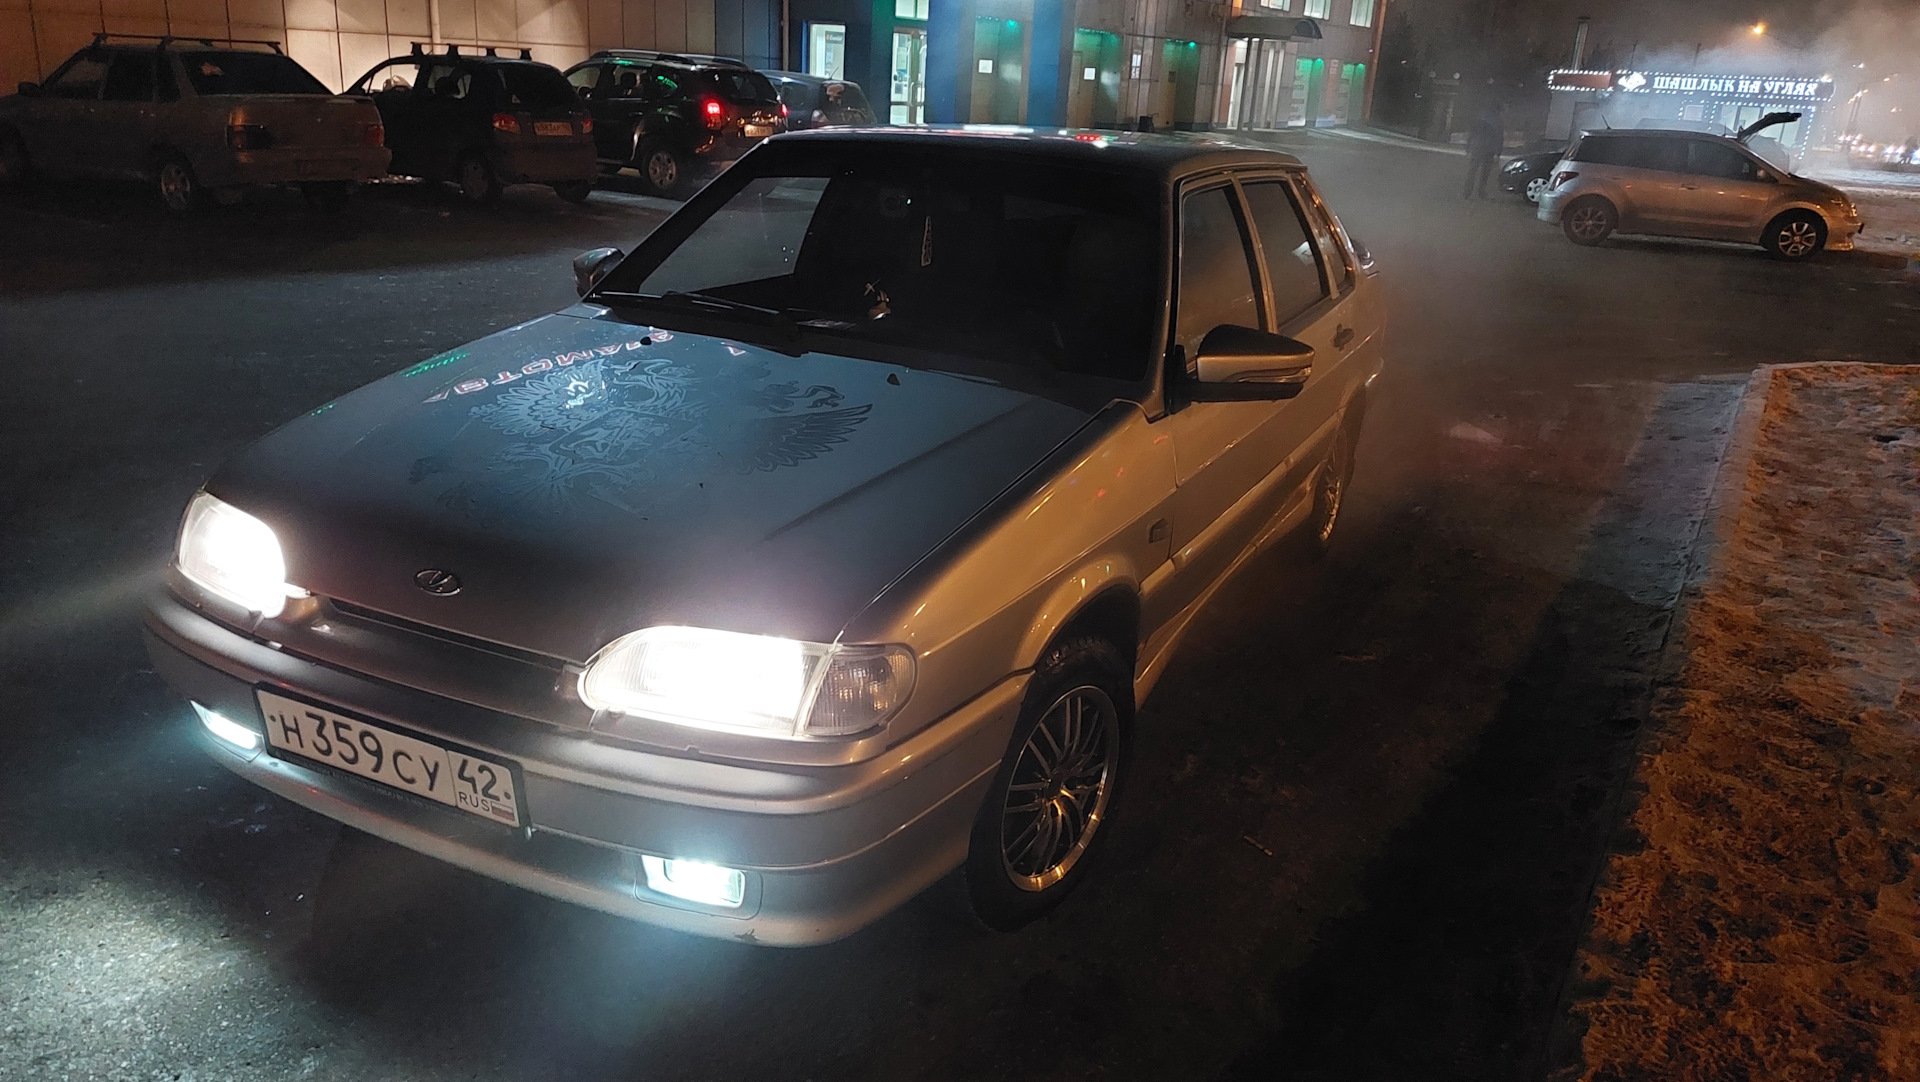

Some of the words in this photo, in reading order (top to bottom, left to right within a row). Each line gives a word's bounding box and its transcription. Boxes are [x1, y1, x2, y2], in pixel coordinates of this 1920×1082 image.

[1653, 76, 1735, 92] ШАШЛЫК
[1737, 80, 1761, 94] НА
[1763, 81, 1818, 96] УГЛЯХ
[281, 711, 439, 791] Н359СУ
[457, 759, 500, 802] 42
[458, 791, 491, 813] RUS
